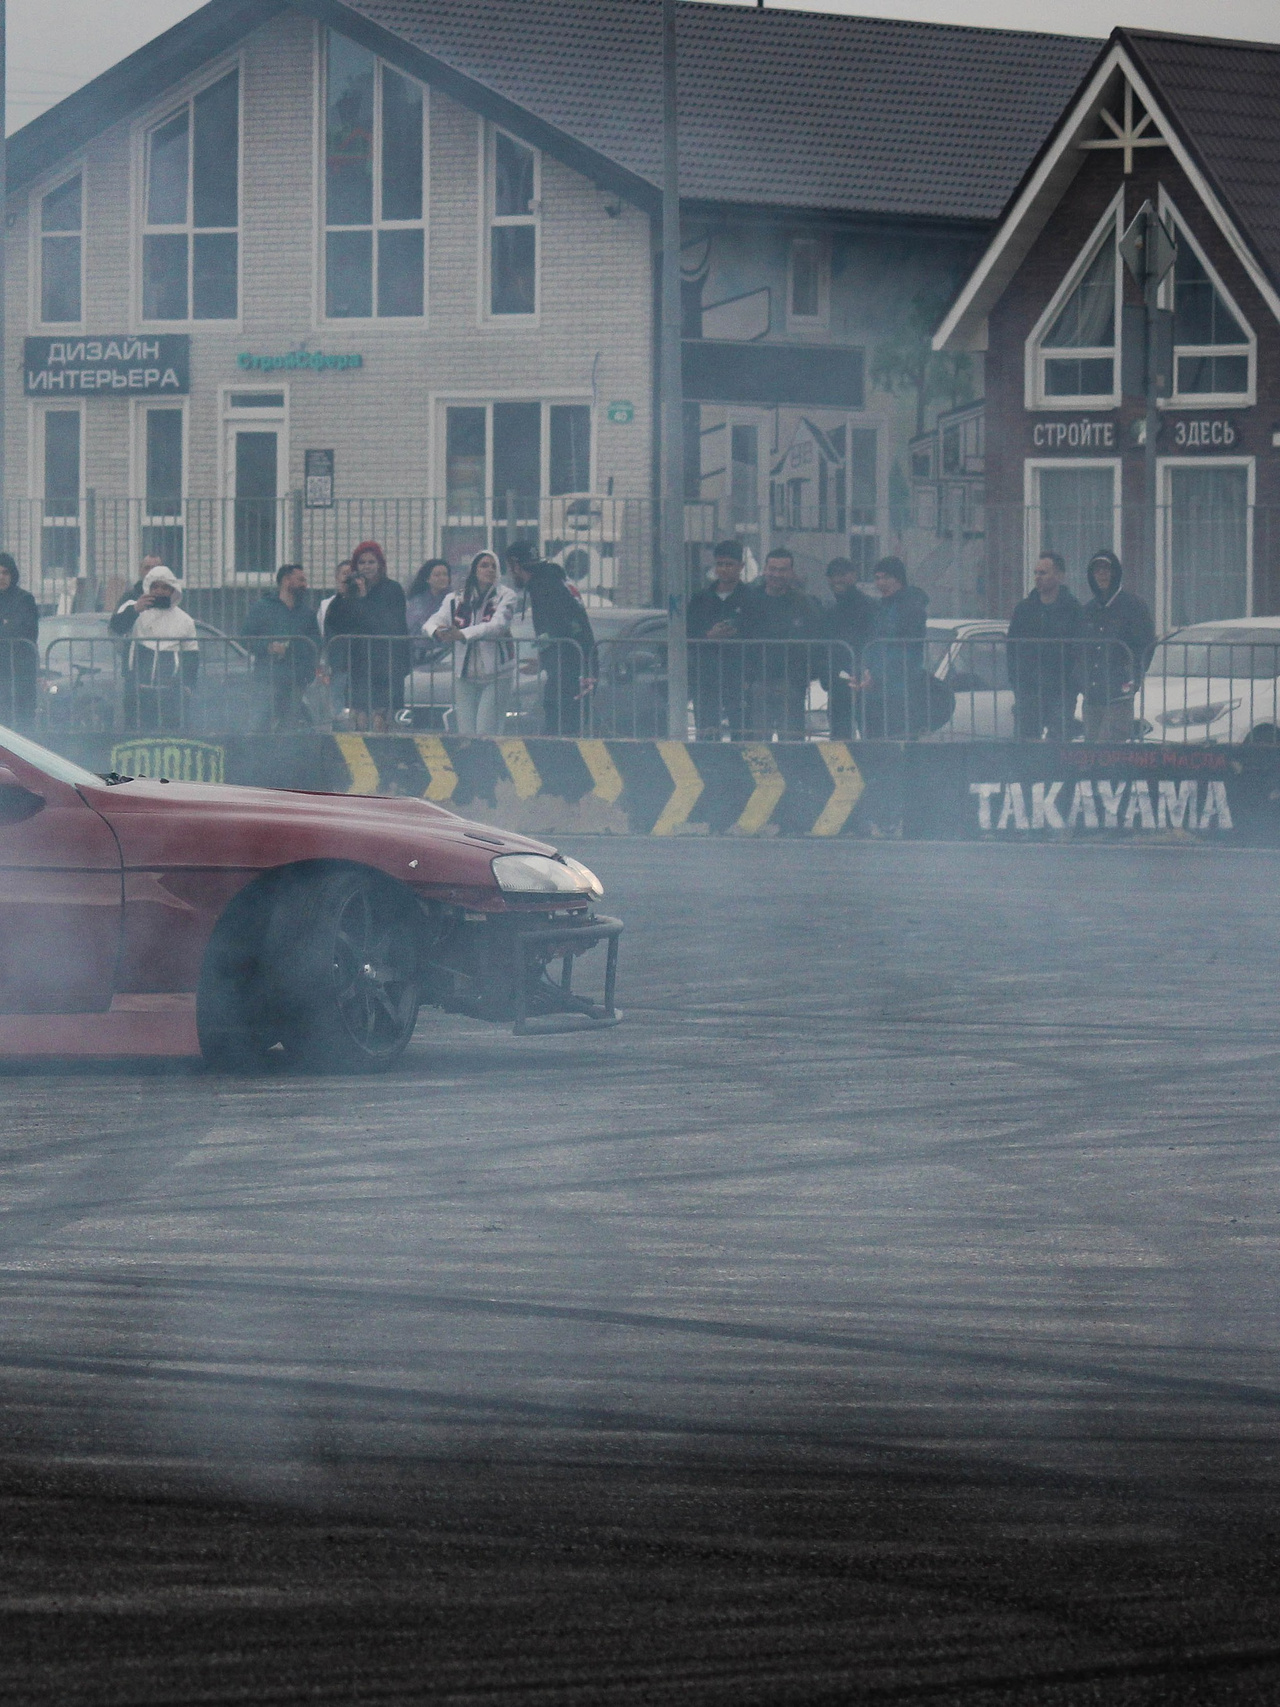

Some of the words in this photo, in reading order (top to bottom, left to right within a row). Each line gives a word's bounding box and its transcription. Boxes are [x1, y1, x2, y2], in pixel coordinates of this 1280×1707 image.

[48, 337, 159, 366] ДИЗАЙН
[28, 368, 180, 390] ИНТЕРЬЕРА
[1033, 419, 1114, 446] СТРОЙТЕ
[1175, 420, 1234, 447] ЗДЕСЬ
[970, 780, 1234, 829] TAKAYAMA
